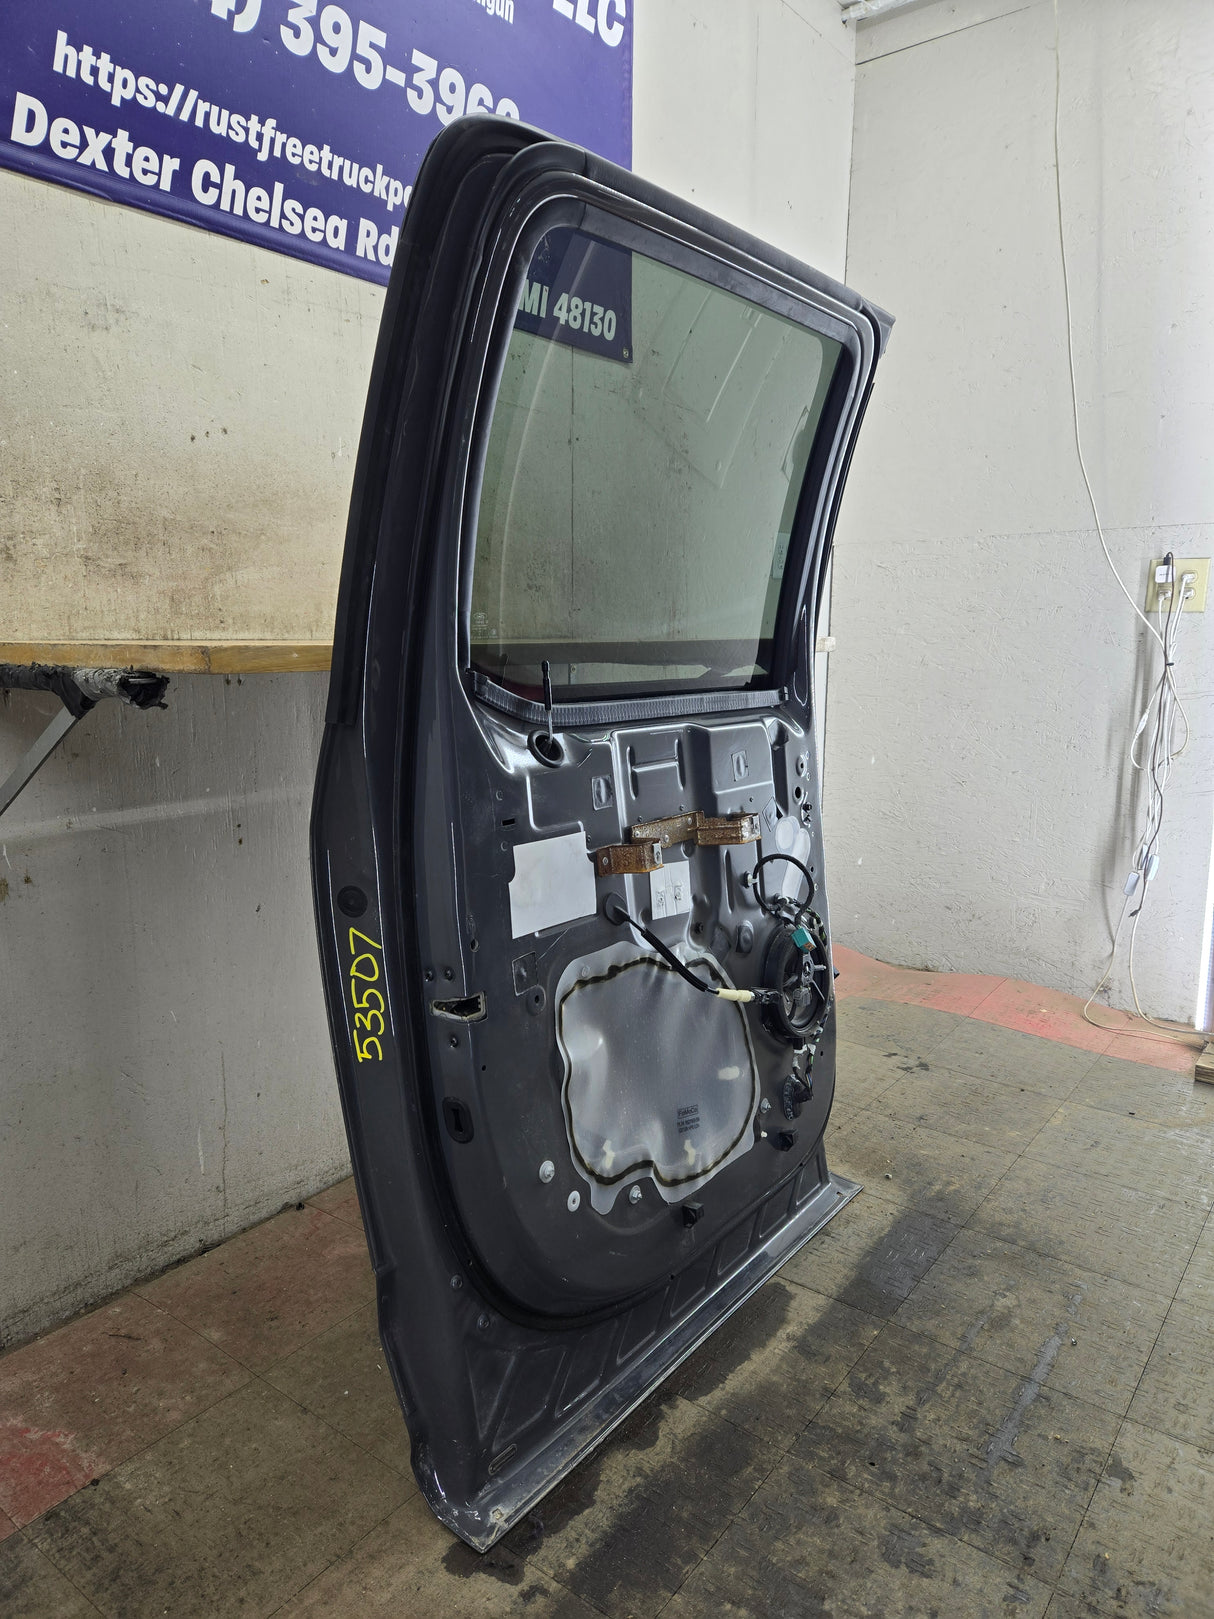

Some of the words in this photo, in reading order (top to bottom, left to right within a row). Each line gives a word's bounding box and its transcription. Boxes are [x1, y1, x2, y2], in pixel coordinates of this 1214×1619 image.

[11, 92, 180, 192] Dexter
[191, 159, 347, 251] Chelsea
[356, 217, 400, 267] Rd
[518, 279, 549, 318] MI
[553, 292, 616, 341] 48130
[349, 927, 385, 1063] 53507
